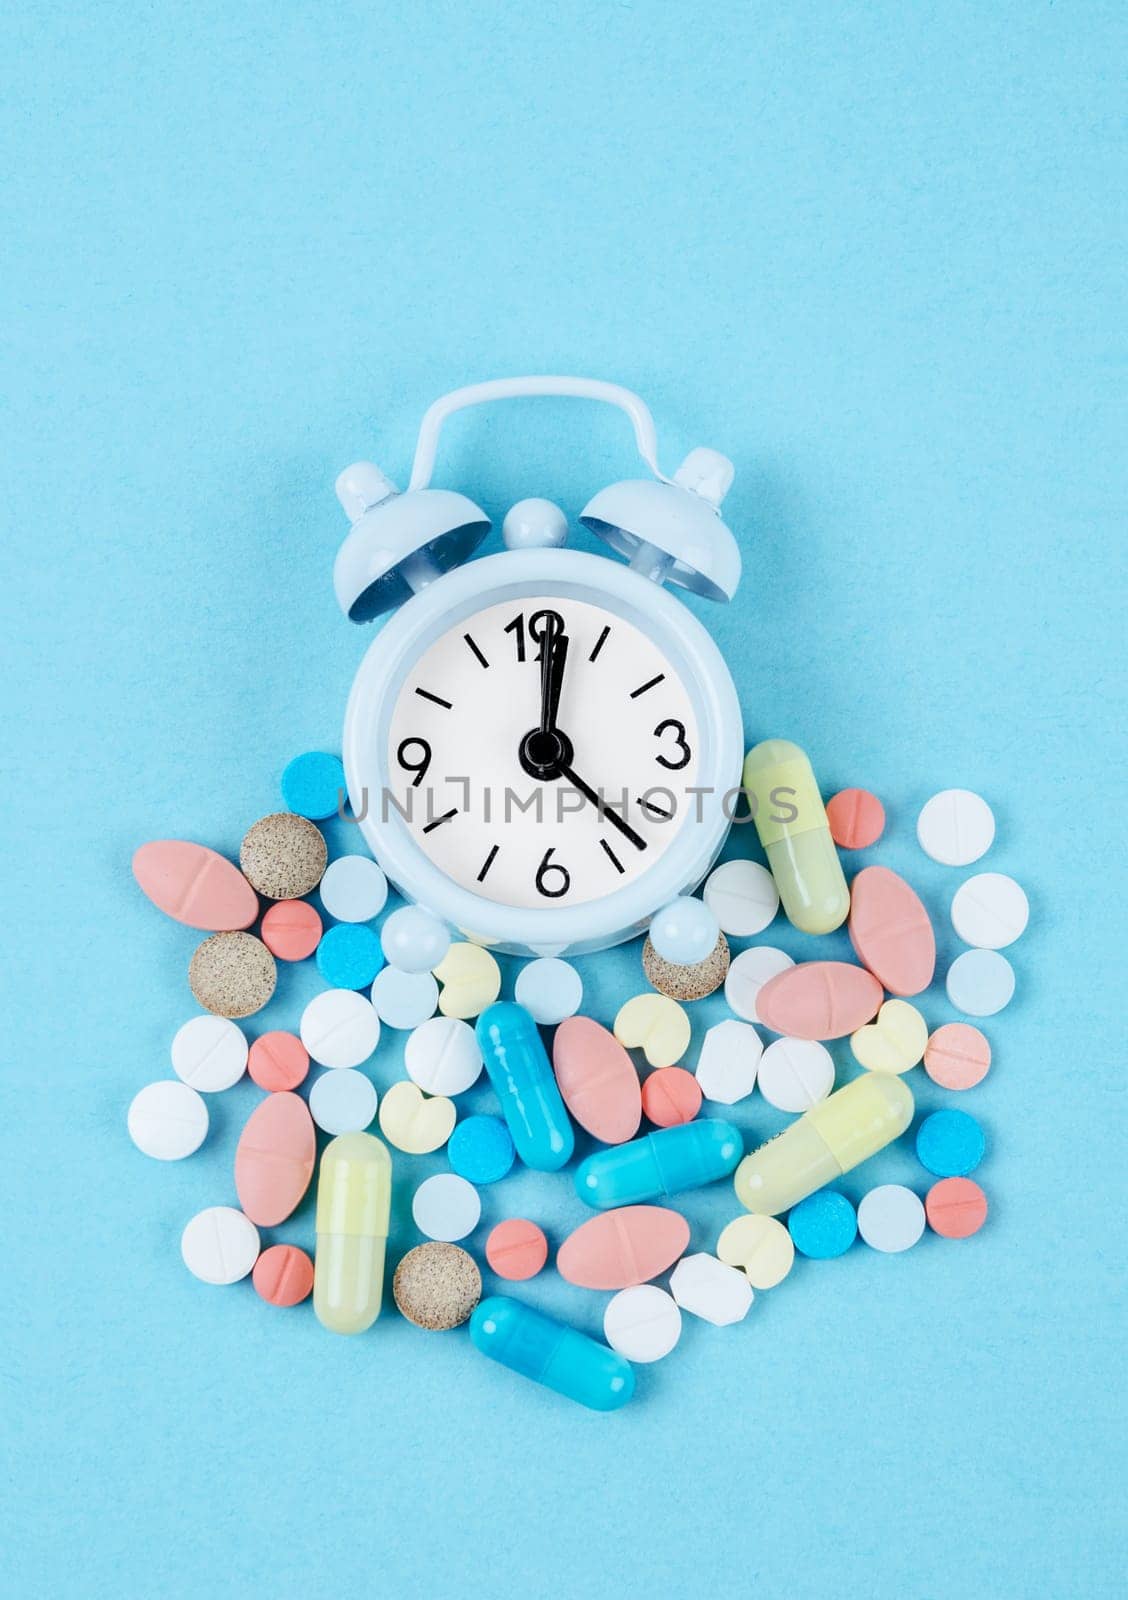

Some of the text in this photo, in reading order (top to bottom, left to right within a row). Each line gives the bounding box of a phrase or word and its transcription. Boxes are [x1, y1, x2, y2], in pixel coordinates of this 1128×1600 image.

[397, 737, 432, 787] 9
[653, 719, 692, 771] 3
[535, 847, 571, 898] 6
